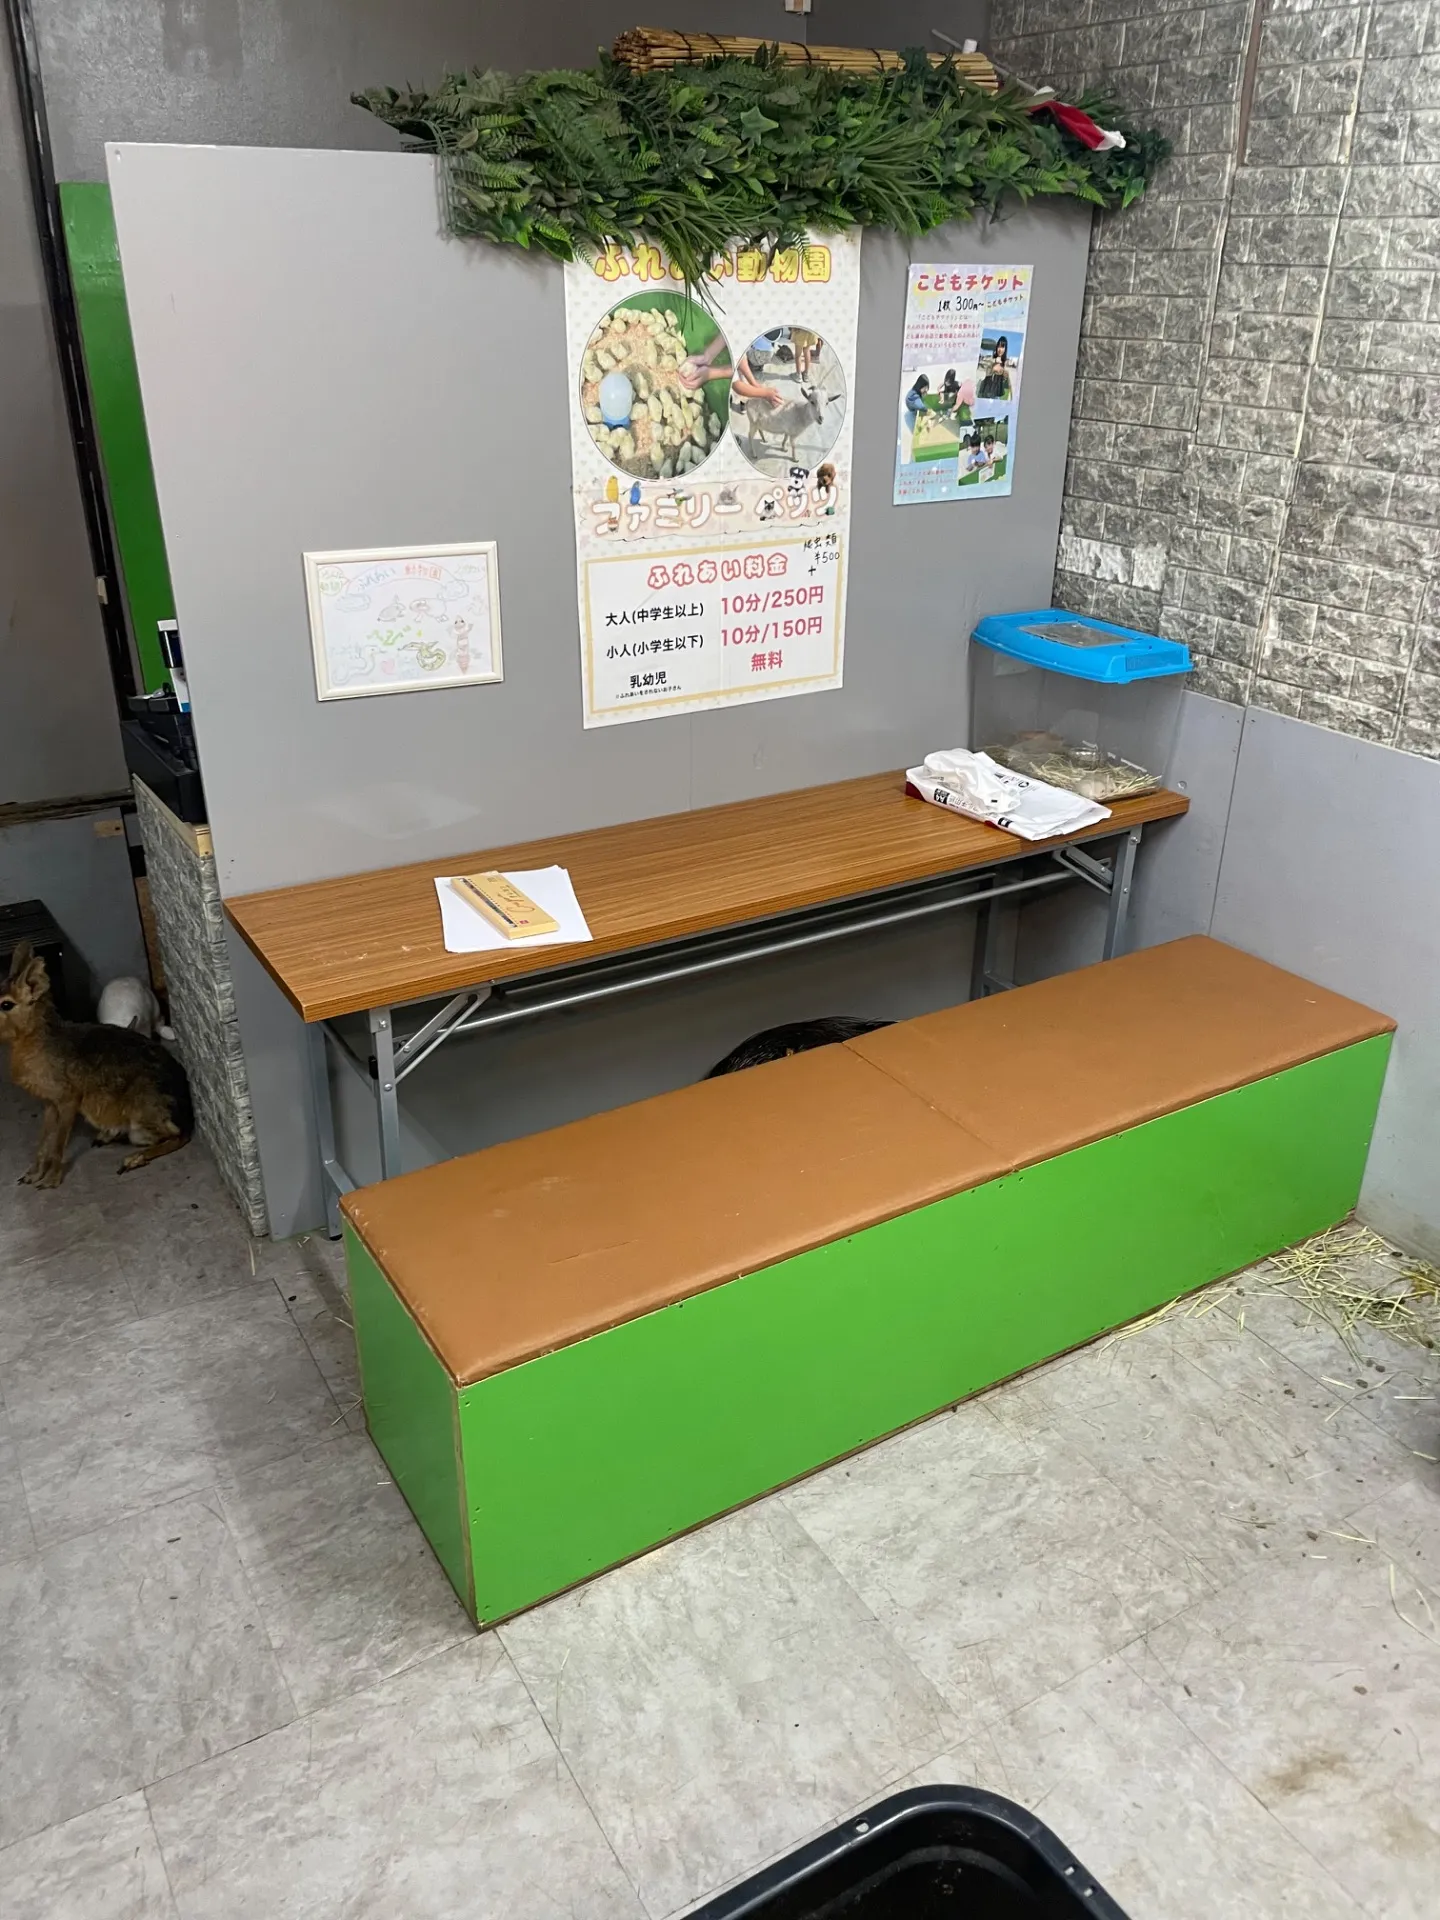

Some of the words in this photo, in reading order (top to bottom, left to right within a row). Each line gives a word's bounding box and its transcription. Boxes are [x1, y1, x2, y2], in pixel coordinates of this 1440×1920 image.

[594, 242, 832, 283] ふれい動物園
[917, 272, 1024, 291] こどもチケット
[987, 293, 1024, 309] こどもチケット
[592, 493, 743, 535] ファミリー
[647, 552, 788, 590] ふれあい料金
[814, 550, 840, 565] ¥500
[605, 602, 705, 627] 大人(中学生以上)
[721, 585, 824, 616] 10分/250円
[606, 634, 704, 660] 小人(小学生以下)
[720, 616, 823, 647] 10分/150円
[629, 671, 667, 689] 乳幼児
[751, 650, 783, 672] 無料
